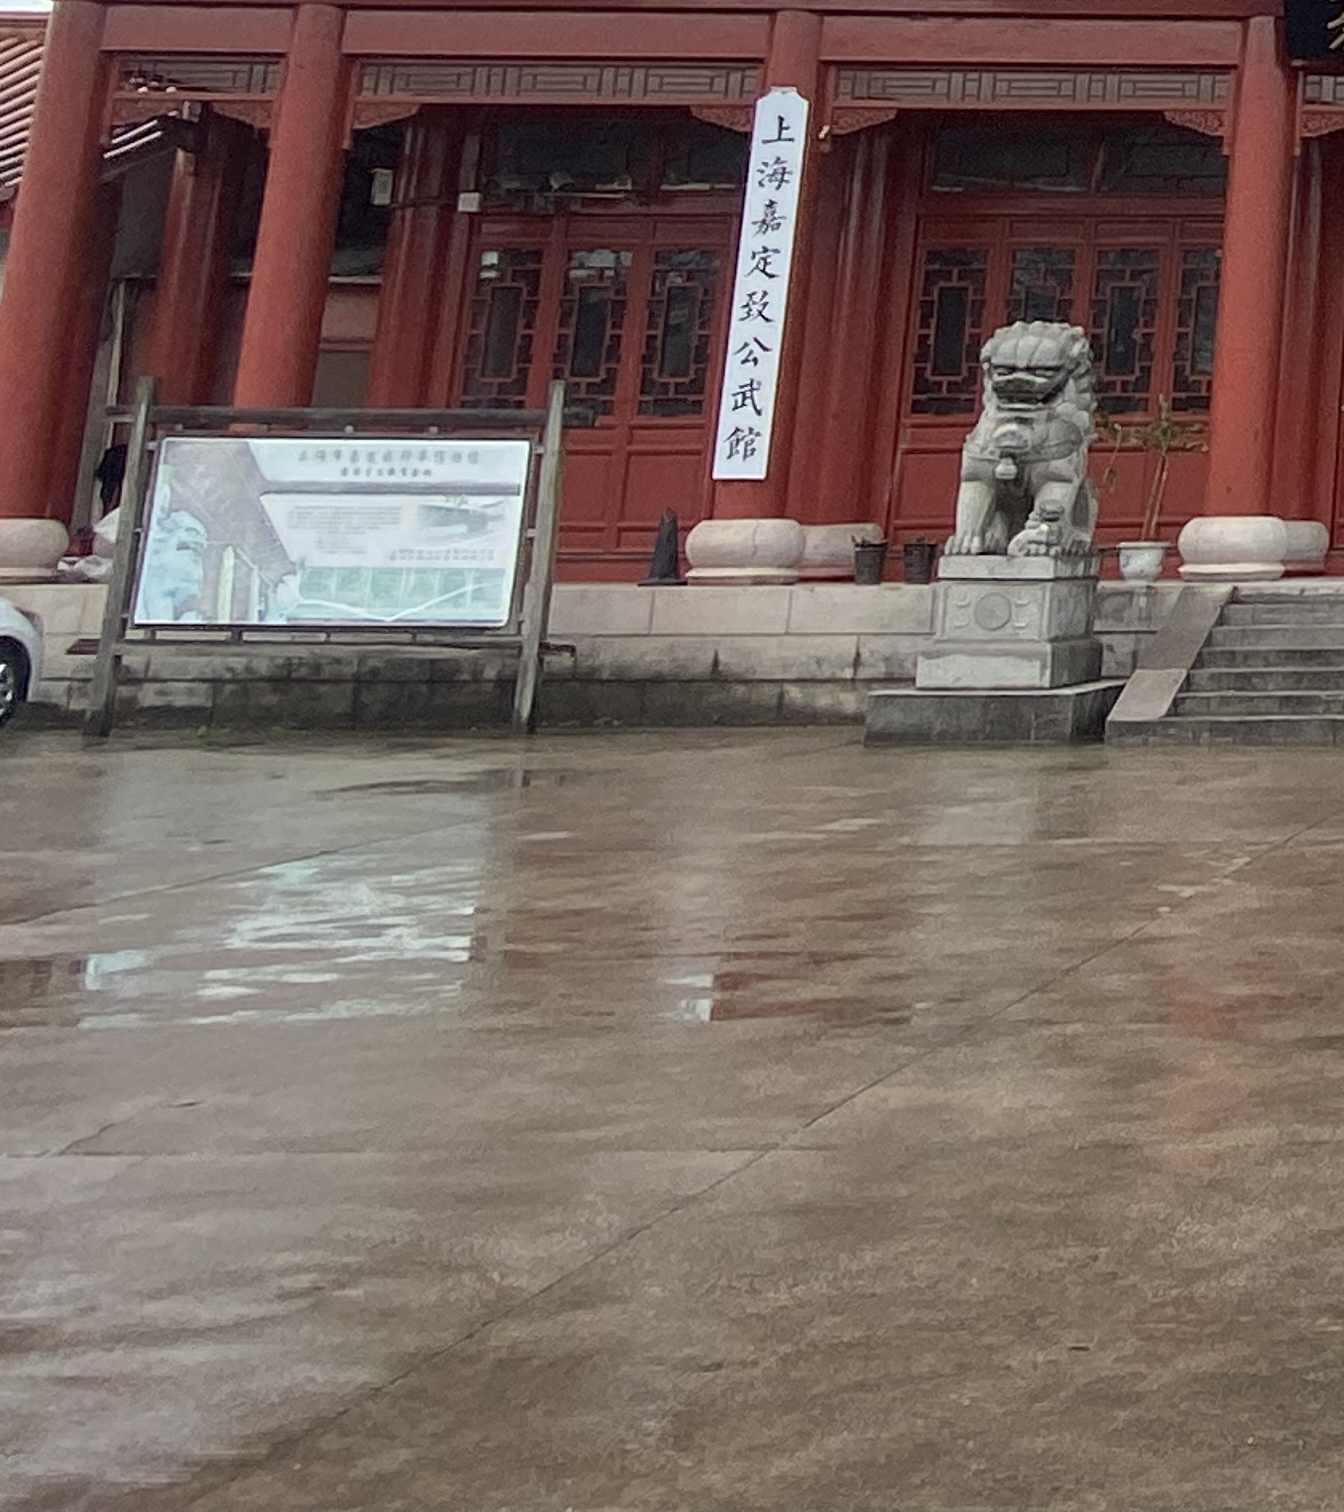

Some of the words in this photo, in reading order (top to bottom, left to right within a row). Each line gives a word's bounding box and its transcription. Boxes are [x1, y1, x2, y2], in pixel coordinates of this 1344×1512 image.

[725, 115, 795, 462] 上海嘉定致公武館
